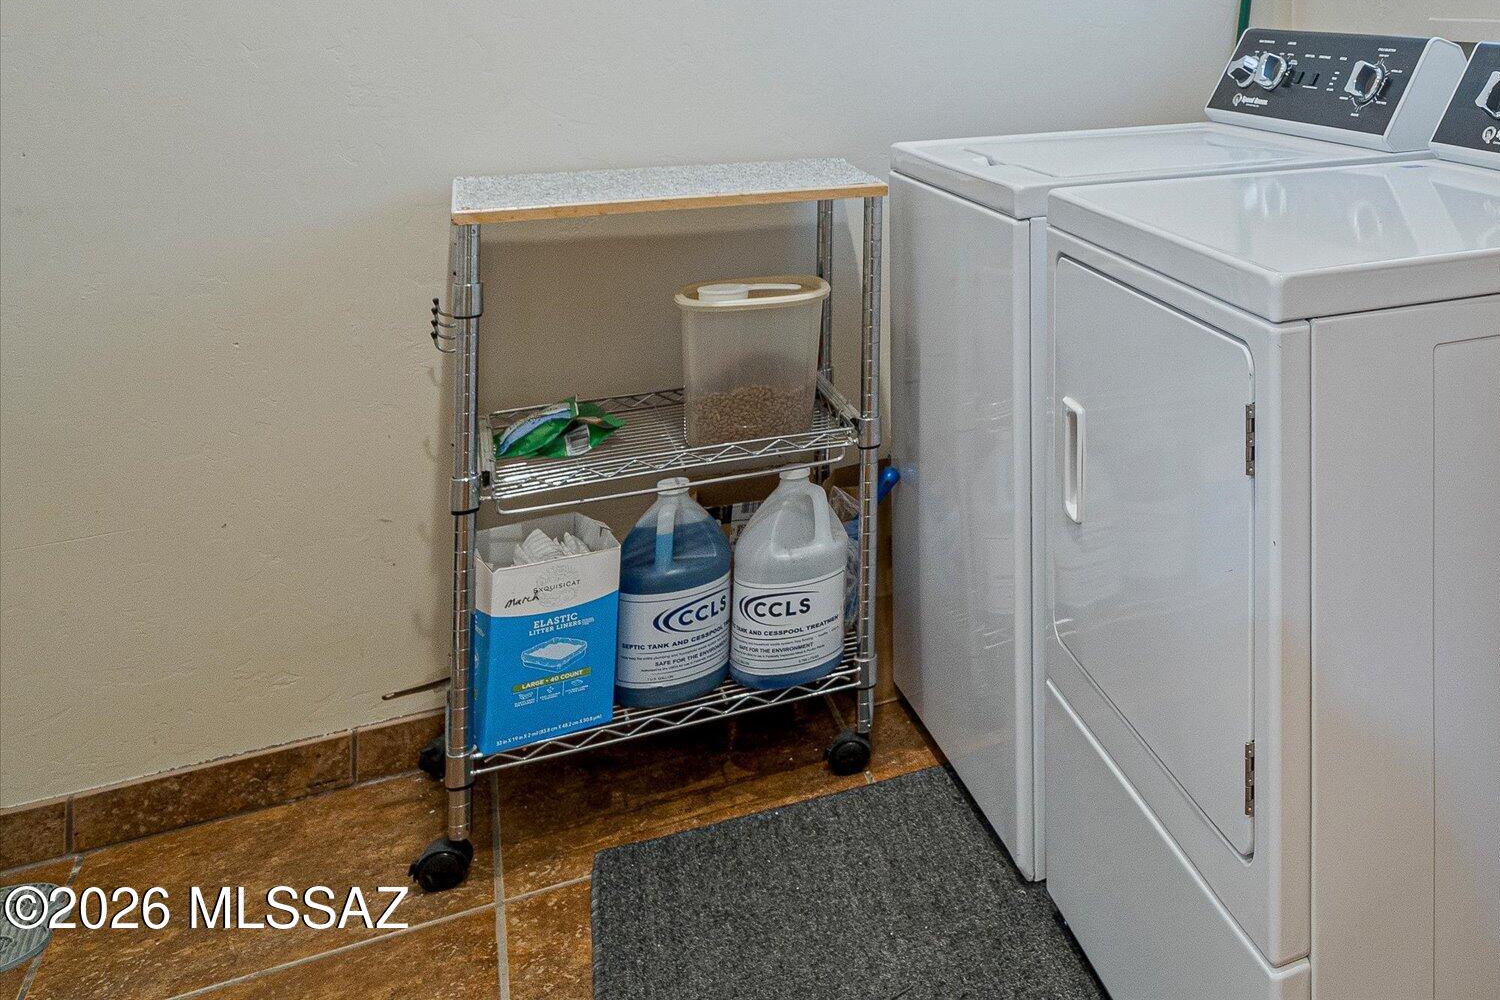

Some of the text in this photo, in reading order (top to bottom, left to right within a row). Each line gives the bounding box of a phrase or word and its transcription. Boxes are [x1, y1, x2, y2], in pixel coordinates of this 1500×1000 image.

[678, 595, 727, 626] CCLS
[754, 598, 811, 617] CCLS
[528, 625, 554, 636] LITTER
[556, 619, 582, 630] LINERS
[533, 612, 578, 630] ELASTIC
[621, 643, 646, 651] SEPTIC
[647, 642, 669, 650] TANK
[672, 639, 689, 647] AND
[691, 625, 723, 642] CESSPOOL
[763, 627, 804, 637] CESSPOOL
[771, 641, 814, 653] ENVIRONMENT
[521, 679, 544, 690] LARGE
[560, 669, 584, 680] COUNT
